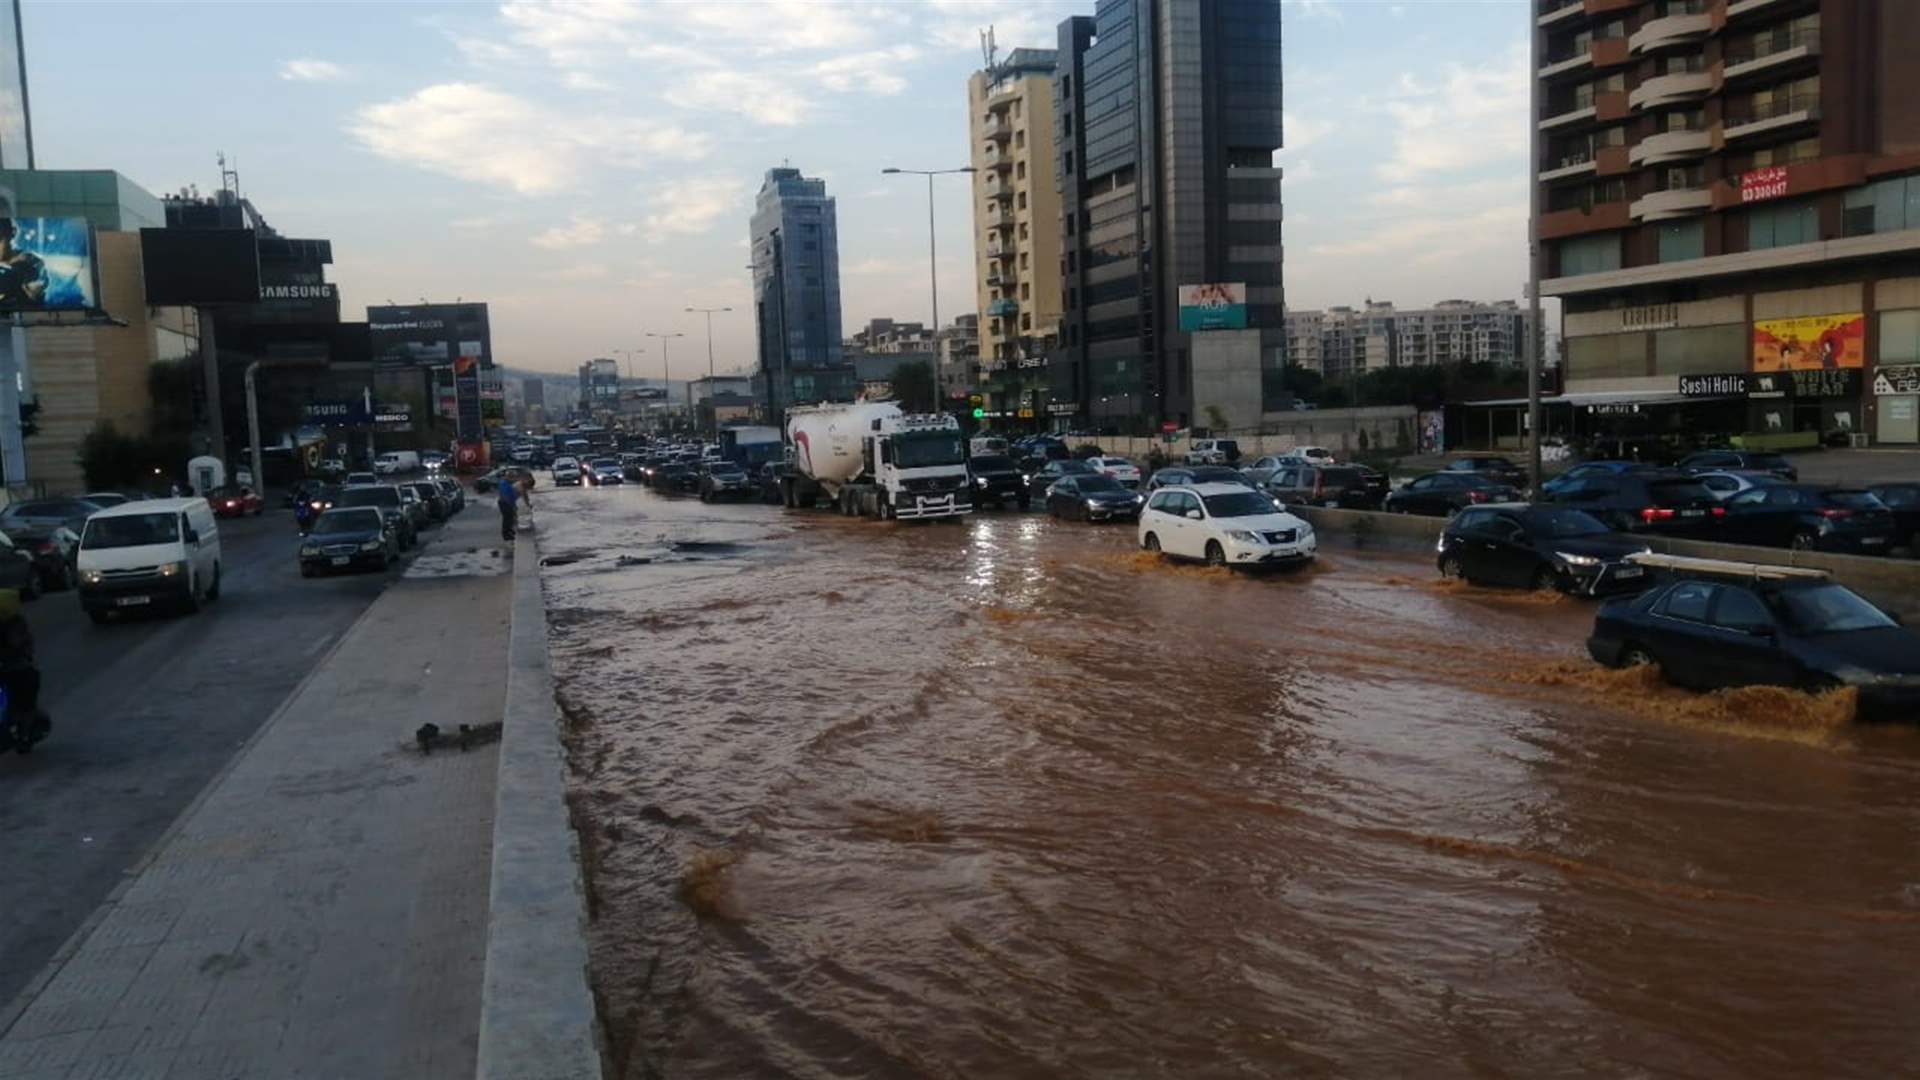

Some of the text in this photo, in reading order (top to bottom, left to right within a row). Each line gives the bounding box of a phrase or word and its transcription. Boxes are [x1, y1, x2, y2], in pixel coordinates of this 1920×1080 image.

[1791, 370, 1849, 384] WHITE
[1681, 376, 1745, 394] Sushi Holic
[1796, 384, 1845, 397] BEAR
